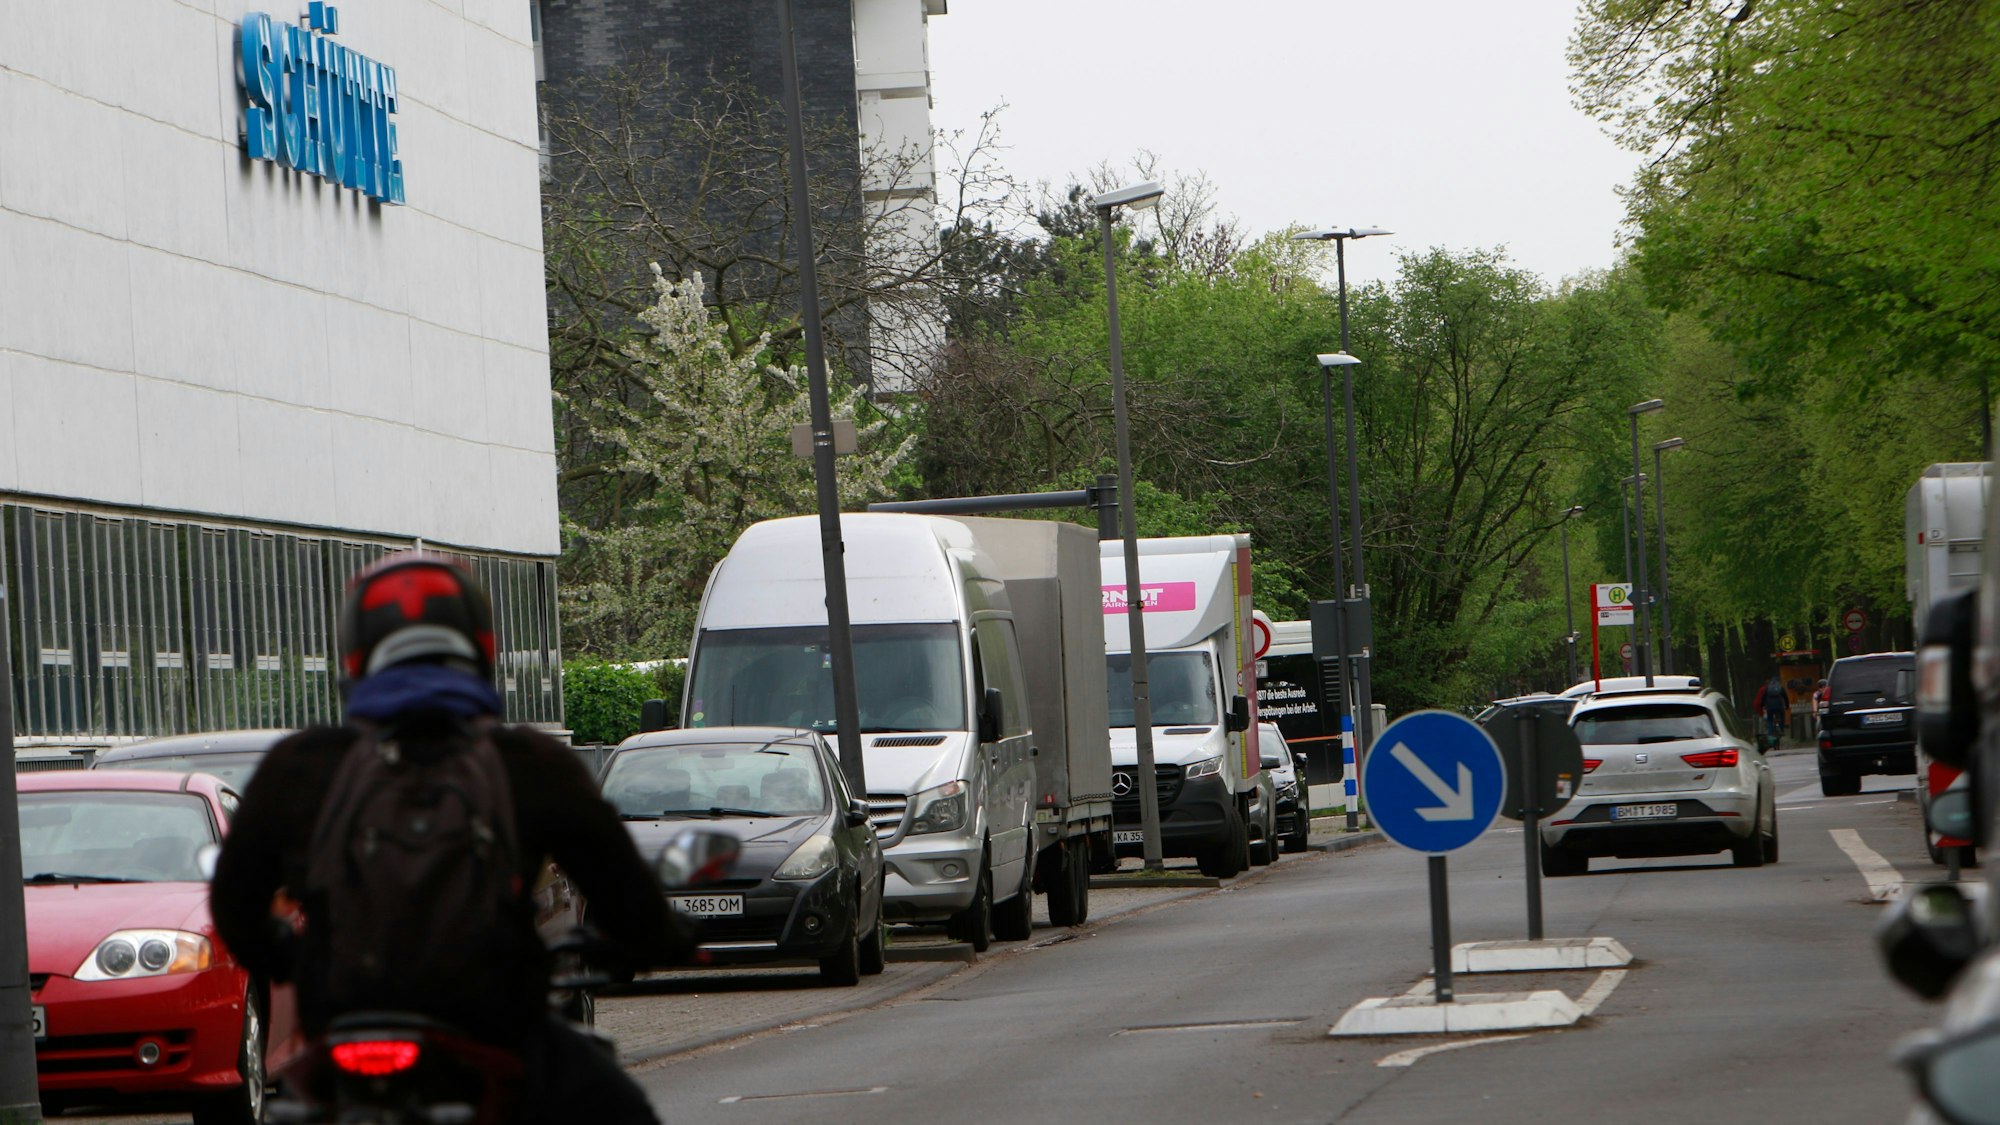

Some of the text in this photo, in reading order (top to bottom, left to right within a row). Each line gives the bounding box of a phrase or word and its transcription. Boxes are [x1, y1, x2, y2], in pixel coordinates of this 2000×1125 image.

[241, 1, 405, 206] SCHÜTTE
[1274, 689, 1288, 699] beste
[1287, 687, 1306, 698] Ausrede
[1286, 704, 1295, 714] bei
[1294, 703, 1303, 714] der
[1617, 804, 1676, 818] BM T 1985
[1117, 832, 1128, 842] KA
[684, 899, 715, 912] 3685
[718, 898, 740, 912] OM
